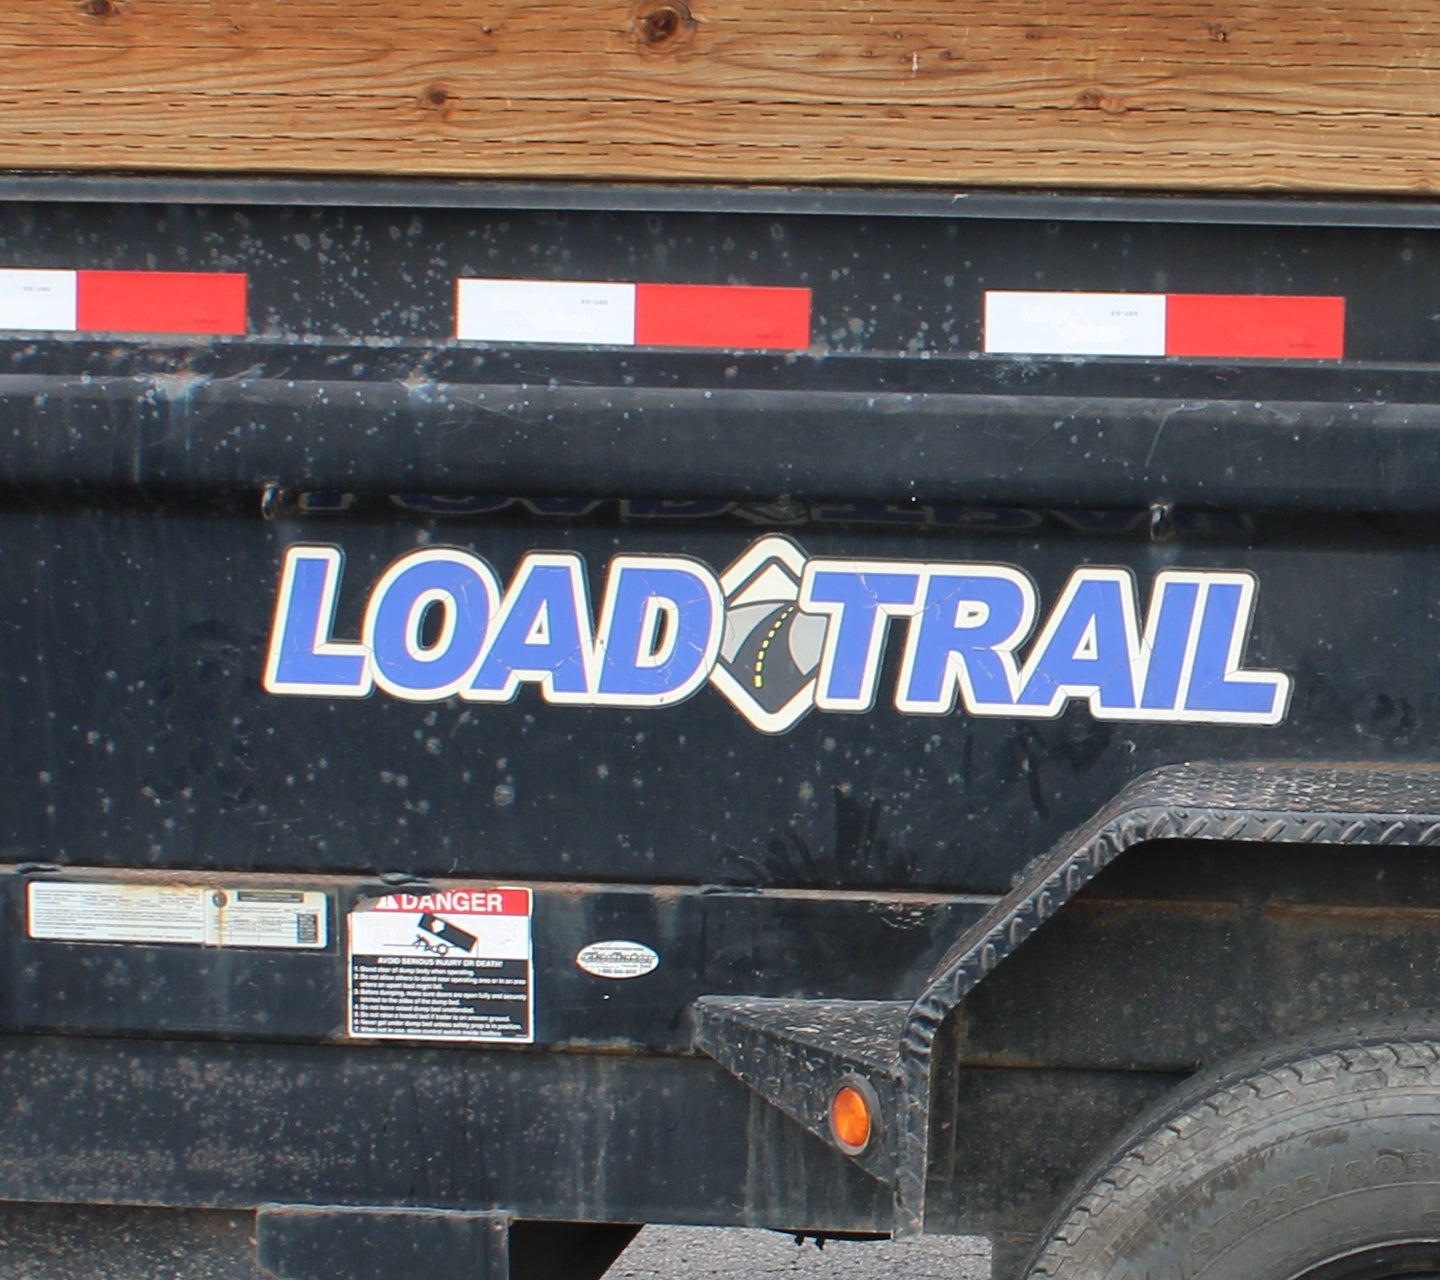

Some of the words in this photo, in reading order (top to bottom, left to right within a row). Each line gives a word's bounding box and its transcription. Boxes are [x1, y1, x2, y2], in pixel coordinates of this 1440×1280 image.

[270, 542, 723, 707] LOAD
[800, 558, 1294, 725] TRAIL
[402, 892, 503, 912] DANGER
